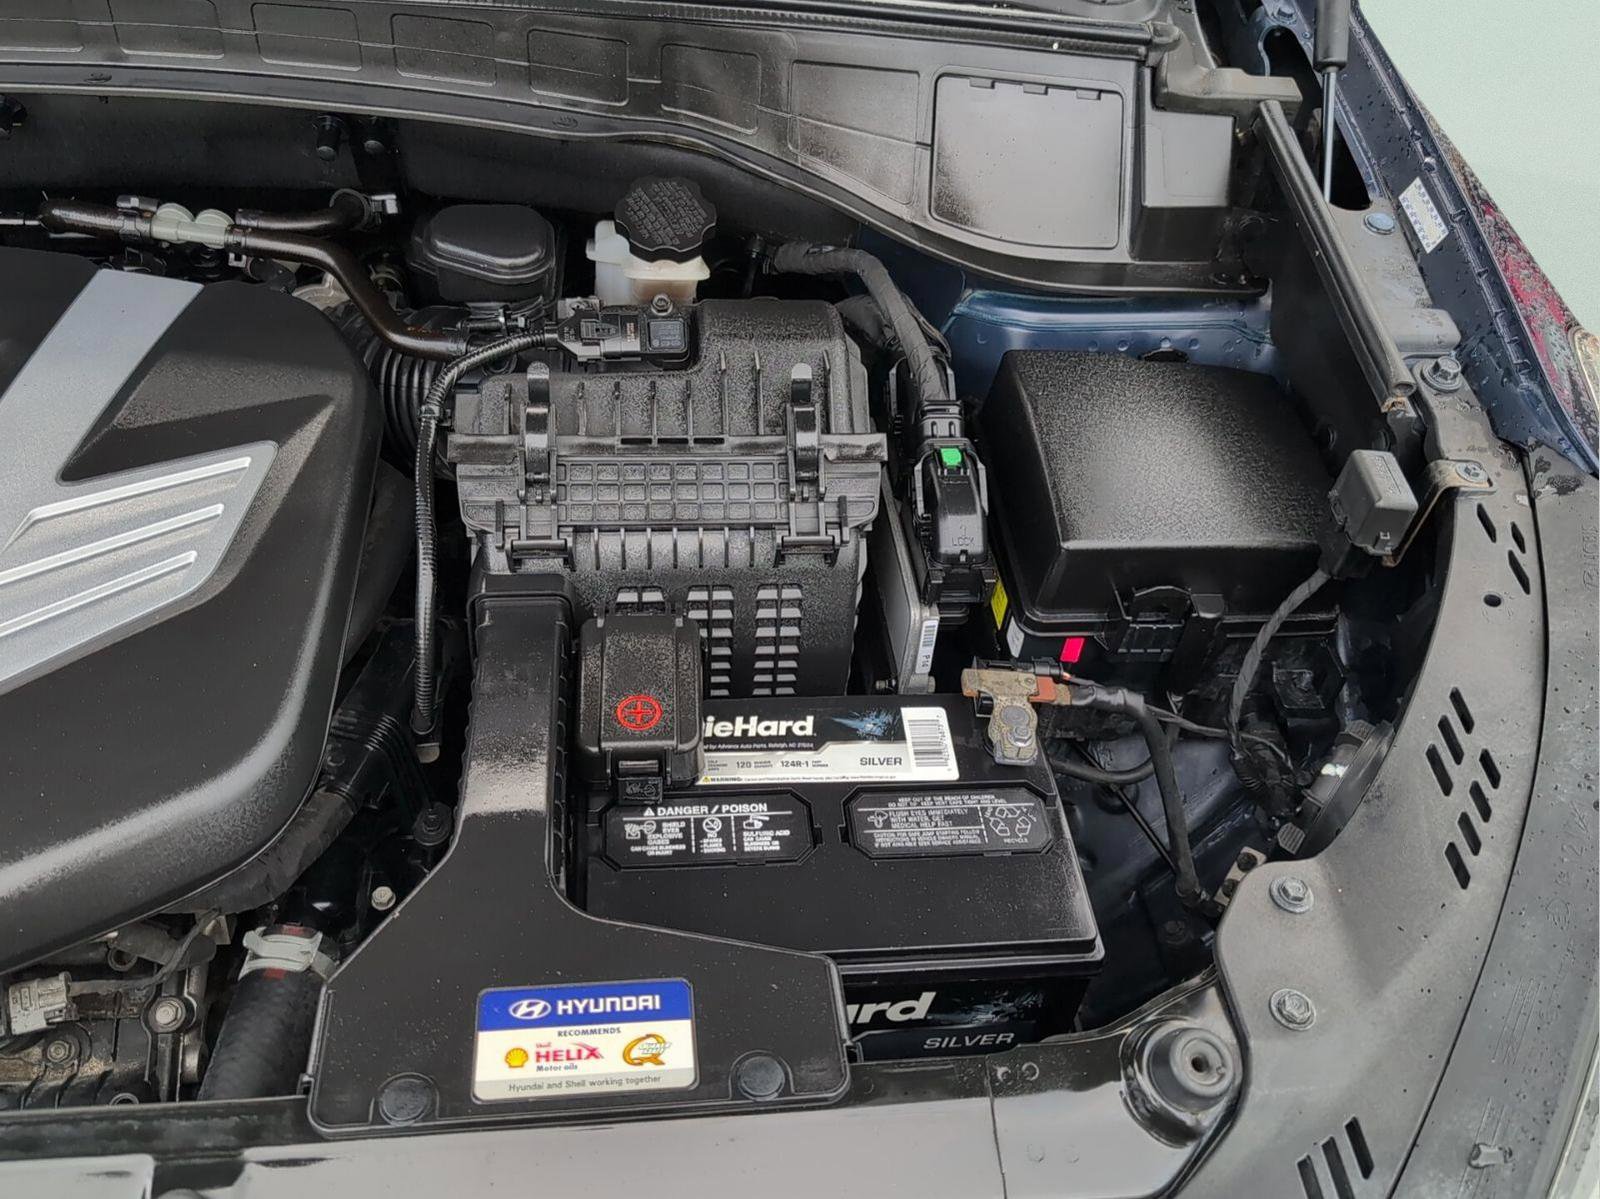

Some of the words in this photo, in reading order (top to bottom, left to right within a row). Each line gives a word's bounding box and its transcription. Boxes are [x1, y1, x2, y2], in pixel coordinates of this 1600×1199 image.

[702, 715, 815, 737] ieHard
[736, 761, 752, 769] 120
[860, 757, 902, 766] SILVER
[657, 805, 709, 816] DANGER
[722, 802, 768, 814] POISON
[558, 994, 660, 1015] HYUNDAI
[558, 1026, 622, 1038] RECOMMENDS
[924, 1033, 1015, 1048] SILVER
[536, 1045, 603, 1063] HELIX
[536, 1064, 562, 1072] Motor
[564, 1062, 578, 1070] oils
[508, 1082, 544, 1092] Hyundai
[546, 1080, 562, 1088] and
[565, 1079, 586, 1088] Shell
[589, 1077, 623, 1088] working
[626, 1074, 661, 1086] together
